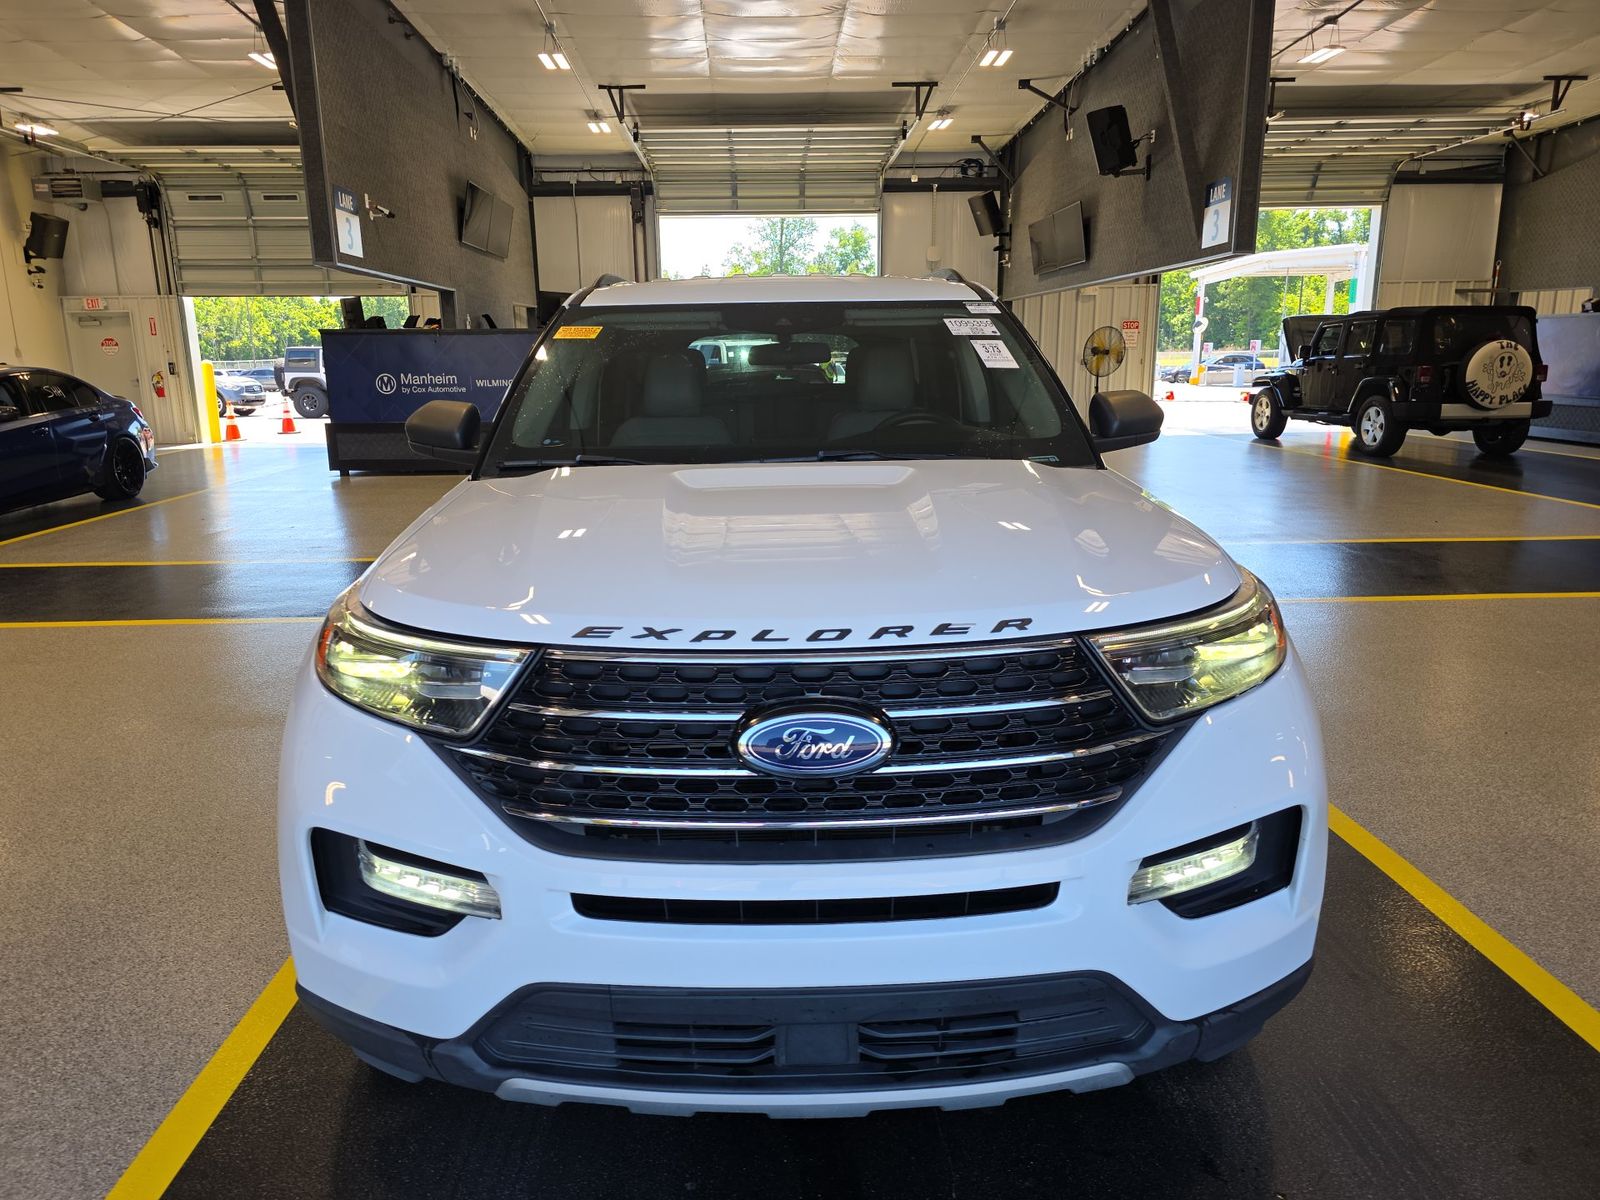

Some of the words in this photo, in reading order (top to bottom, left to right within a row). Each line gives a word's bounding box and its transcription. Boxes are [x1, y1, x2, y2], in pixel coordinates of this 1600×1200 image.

[338, 191, 354, 211] LANE
[1210, 183, 1226, 203] LANE
[345, 217, 354, 250] 3
[1211, 209, 1220, 241] 3
[86, 298, 100, 309] EXIT
[1123, 321, 1139, 329] STOP
[400, 372, 458, 385] Manheim
[401, 386, 411, 395] by
[1465, 379, 1496, 405] HAPPY
[571, 617, 1033, 643] EXPLORER
[774, 727, 855, 760] Ford
